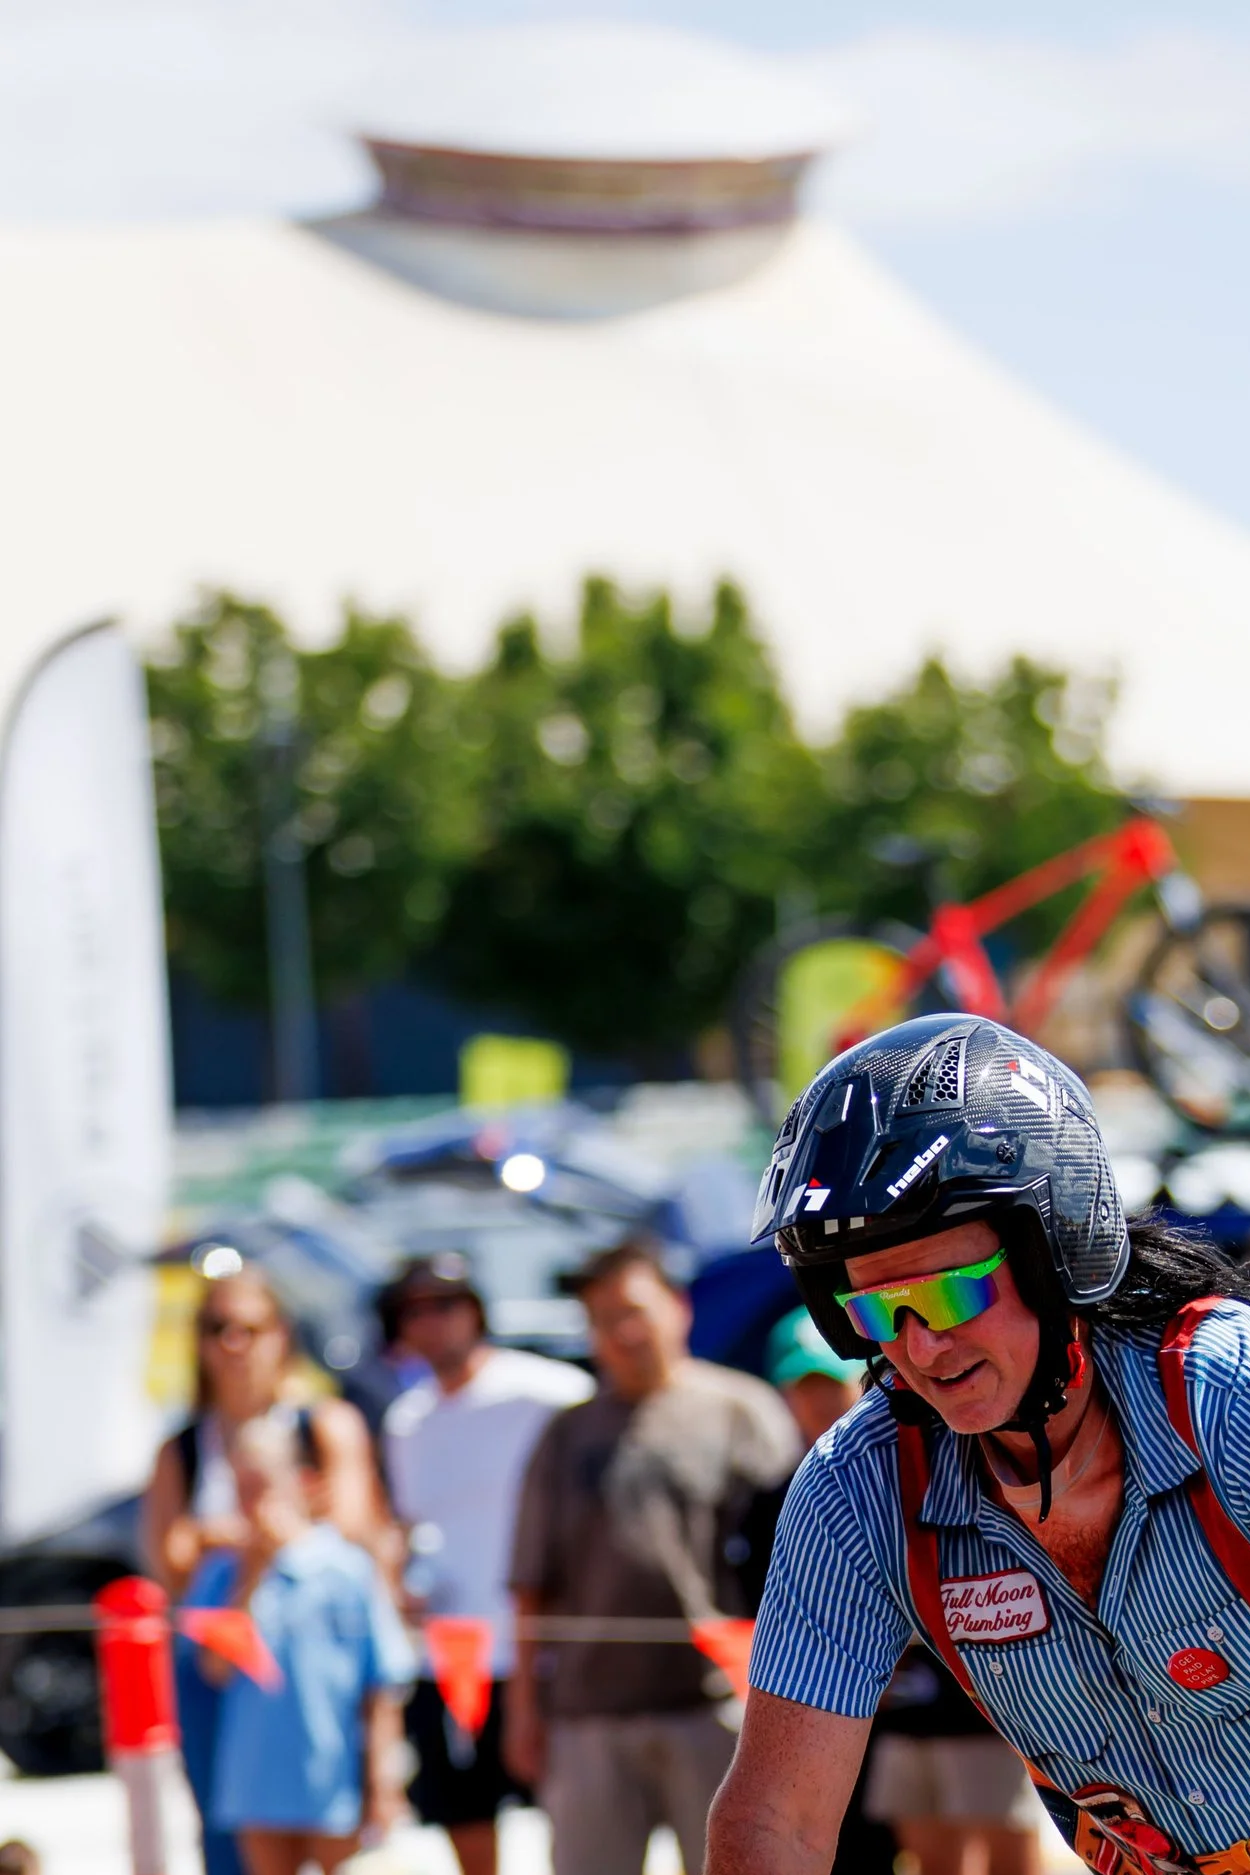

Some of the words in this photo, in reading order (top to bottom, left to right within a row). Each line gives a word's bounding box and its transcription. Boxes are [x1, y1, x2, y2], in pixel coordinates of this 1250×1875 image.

[886, 1134, 949, 1198] hebo
[879, 1287, 911, 1301] Randy
[940, 1587, 975, 1609] Full
[974, 1580, 1035, 1608] Moon
[946, 1608, 1033, 1634] Plumbing
[1178, 1653, 1196, 1667] GET
[1182, 1662, 1203, 1675] PAID
[1186, 1674, 1200, 1684] TO
[1199, 1664, 1216, 1677] LAY
[1200, 1673, 1220, 1685] PIPE
